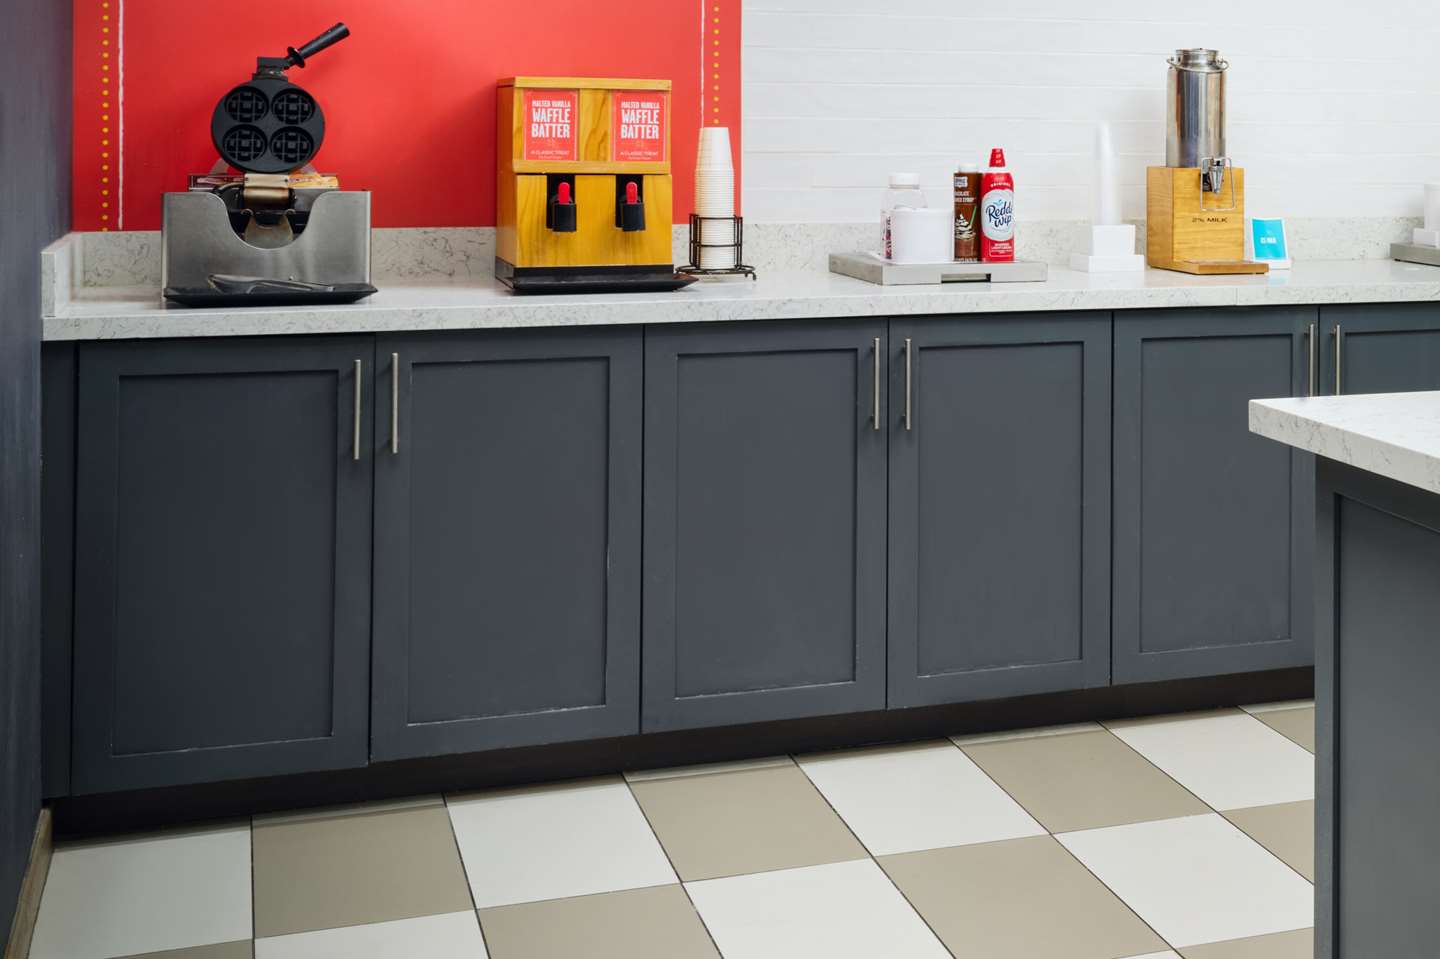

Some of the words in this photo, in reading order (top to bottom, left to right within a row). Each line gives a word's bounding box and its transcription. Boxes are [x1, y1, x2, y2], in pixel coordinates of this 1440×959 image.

[532, 108, 571, 123] WAFFLE
[621, 109, 660, 125] WAFFLE
[531, 123, 571, 138] BATTER
[620, 125, 660, 139] BATTER
